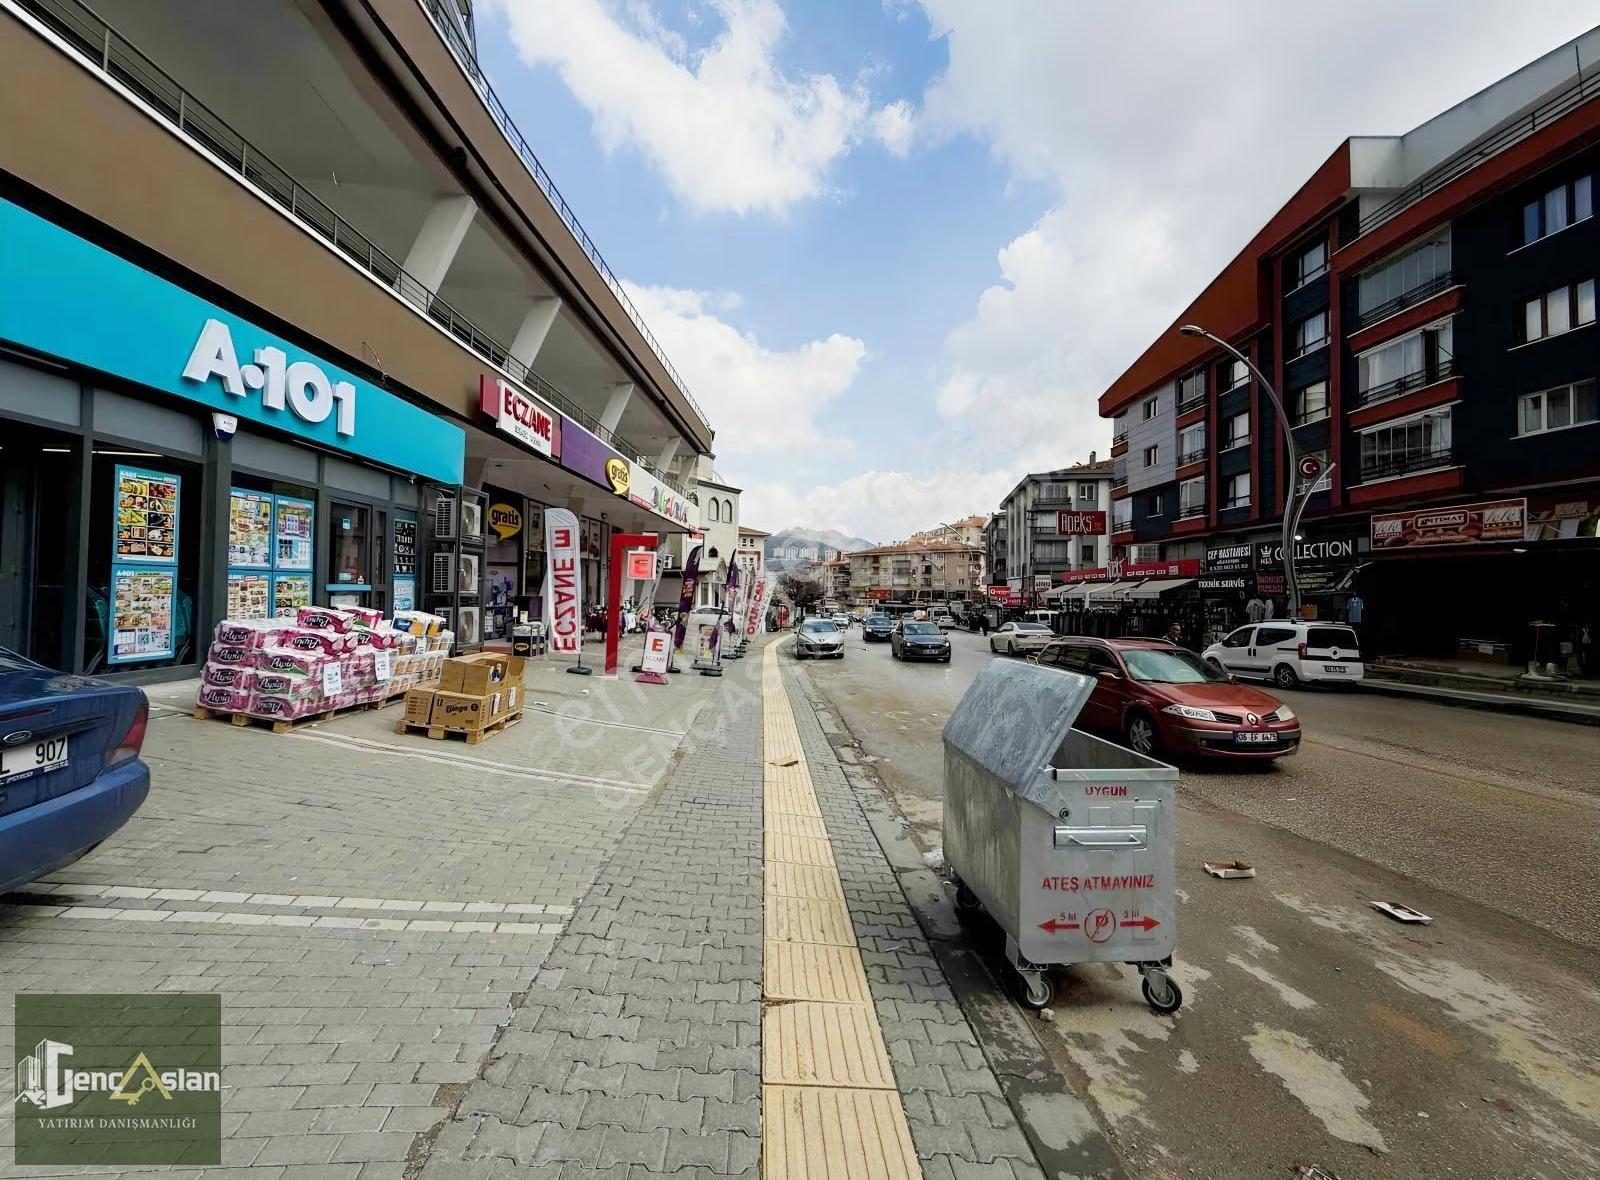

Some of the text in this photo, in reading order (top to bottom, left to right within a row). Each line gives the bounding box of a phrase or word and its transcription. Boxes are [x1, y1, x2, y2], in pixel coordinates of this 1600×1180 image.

[504, 387, 551, 442] ECZANE
[611, 464, 628, 484] gratis
[491, 509, 520, 527] gratis
[634, 559, 650, 575] E
[652, 638, 665, 651] E
[35, 735, 66, 765] 907
[1085, 785, 1128, 797] UYGUN
[1042, 874, 1155, 894] ATEŞ ATMAYINIZ
